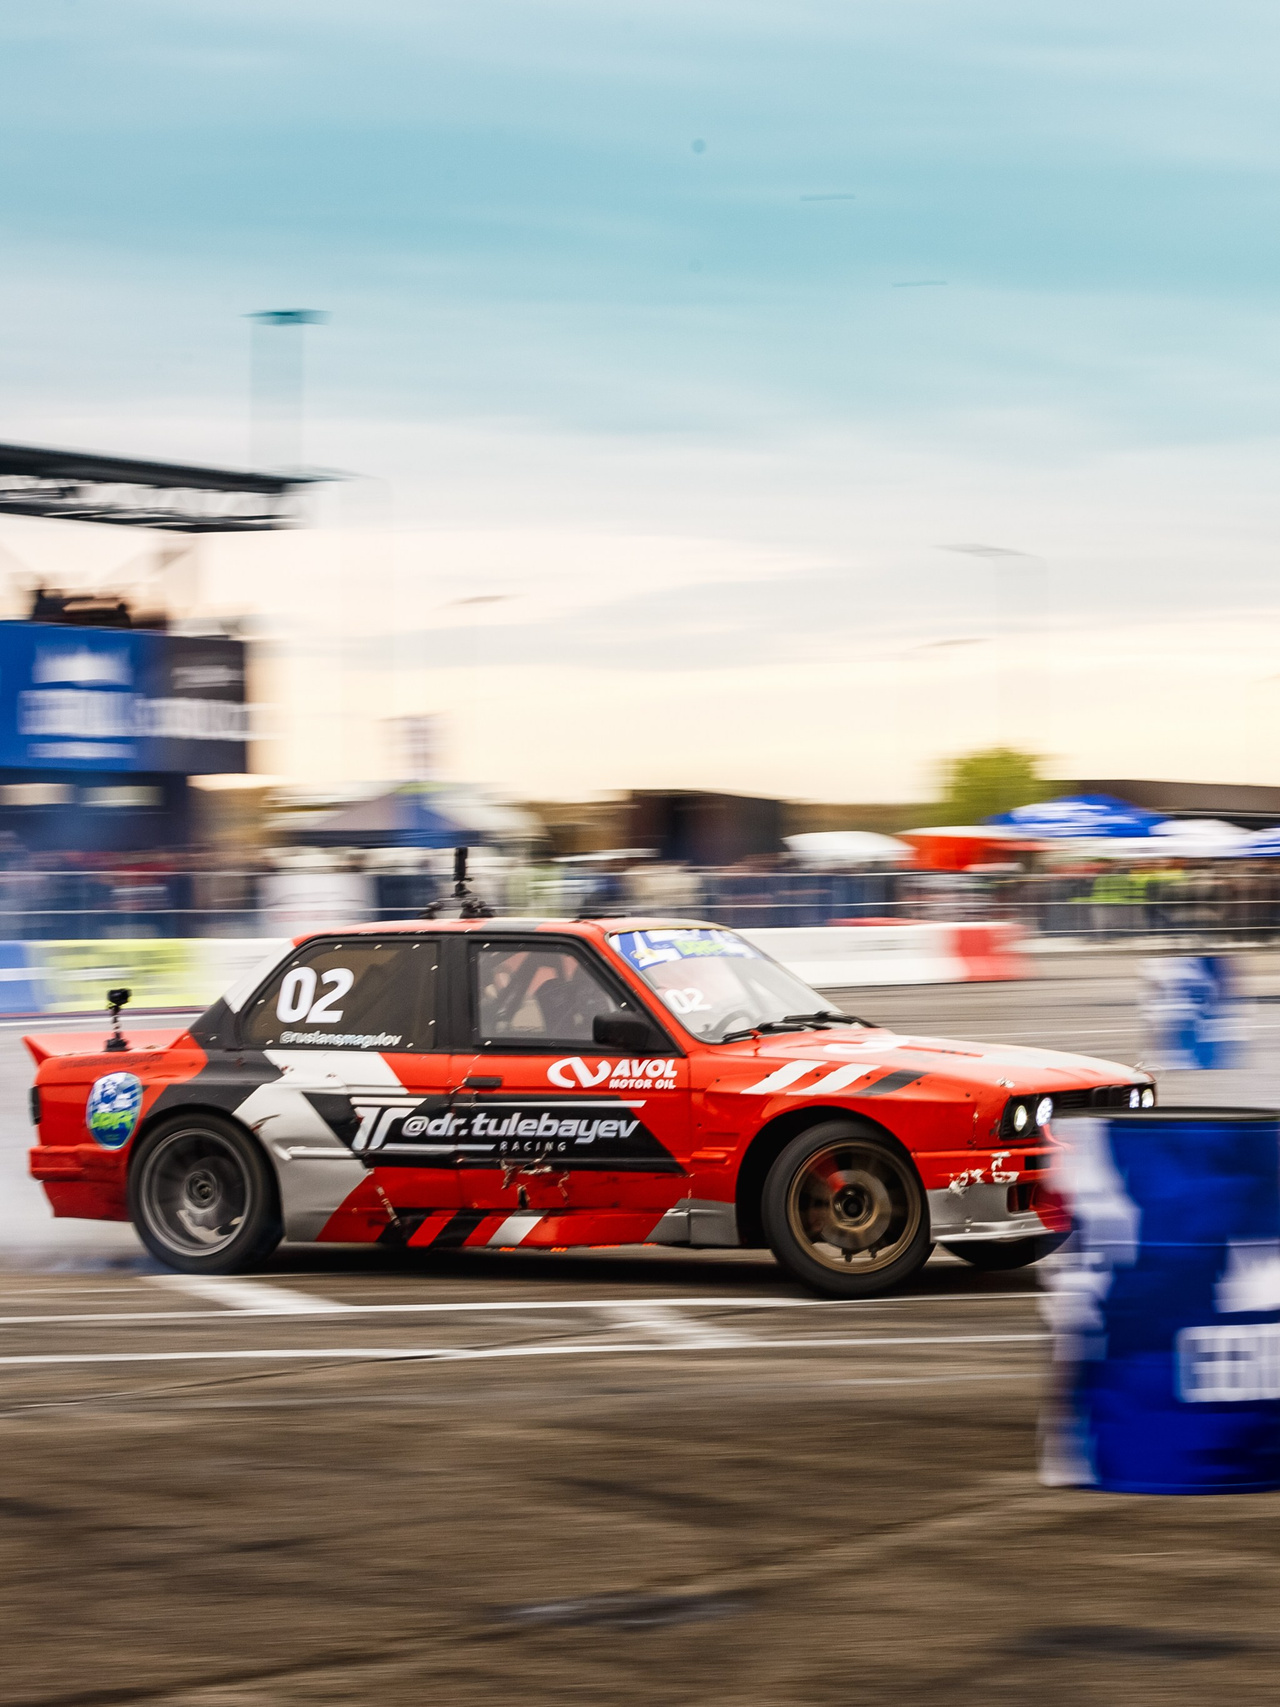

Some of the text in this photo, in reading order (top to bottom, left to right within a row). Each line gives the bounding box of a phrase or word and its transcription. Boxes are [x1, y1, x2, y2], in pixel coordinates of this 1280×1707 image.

[275, 966, 355, 1025] 02
[664, 987, 713, 1015] 02
[611, 1058, 678, 1078] AVOL
[608, 1078, 677, 1090] MOTOR OIL
[401, 1112, 640, 1145] @dr.tulebayev
[499, 1140, 567, 1152] RACING
